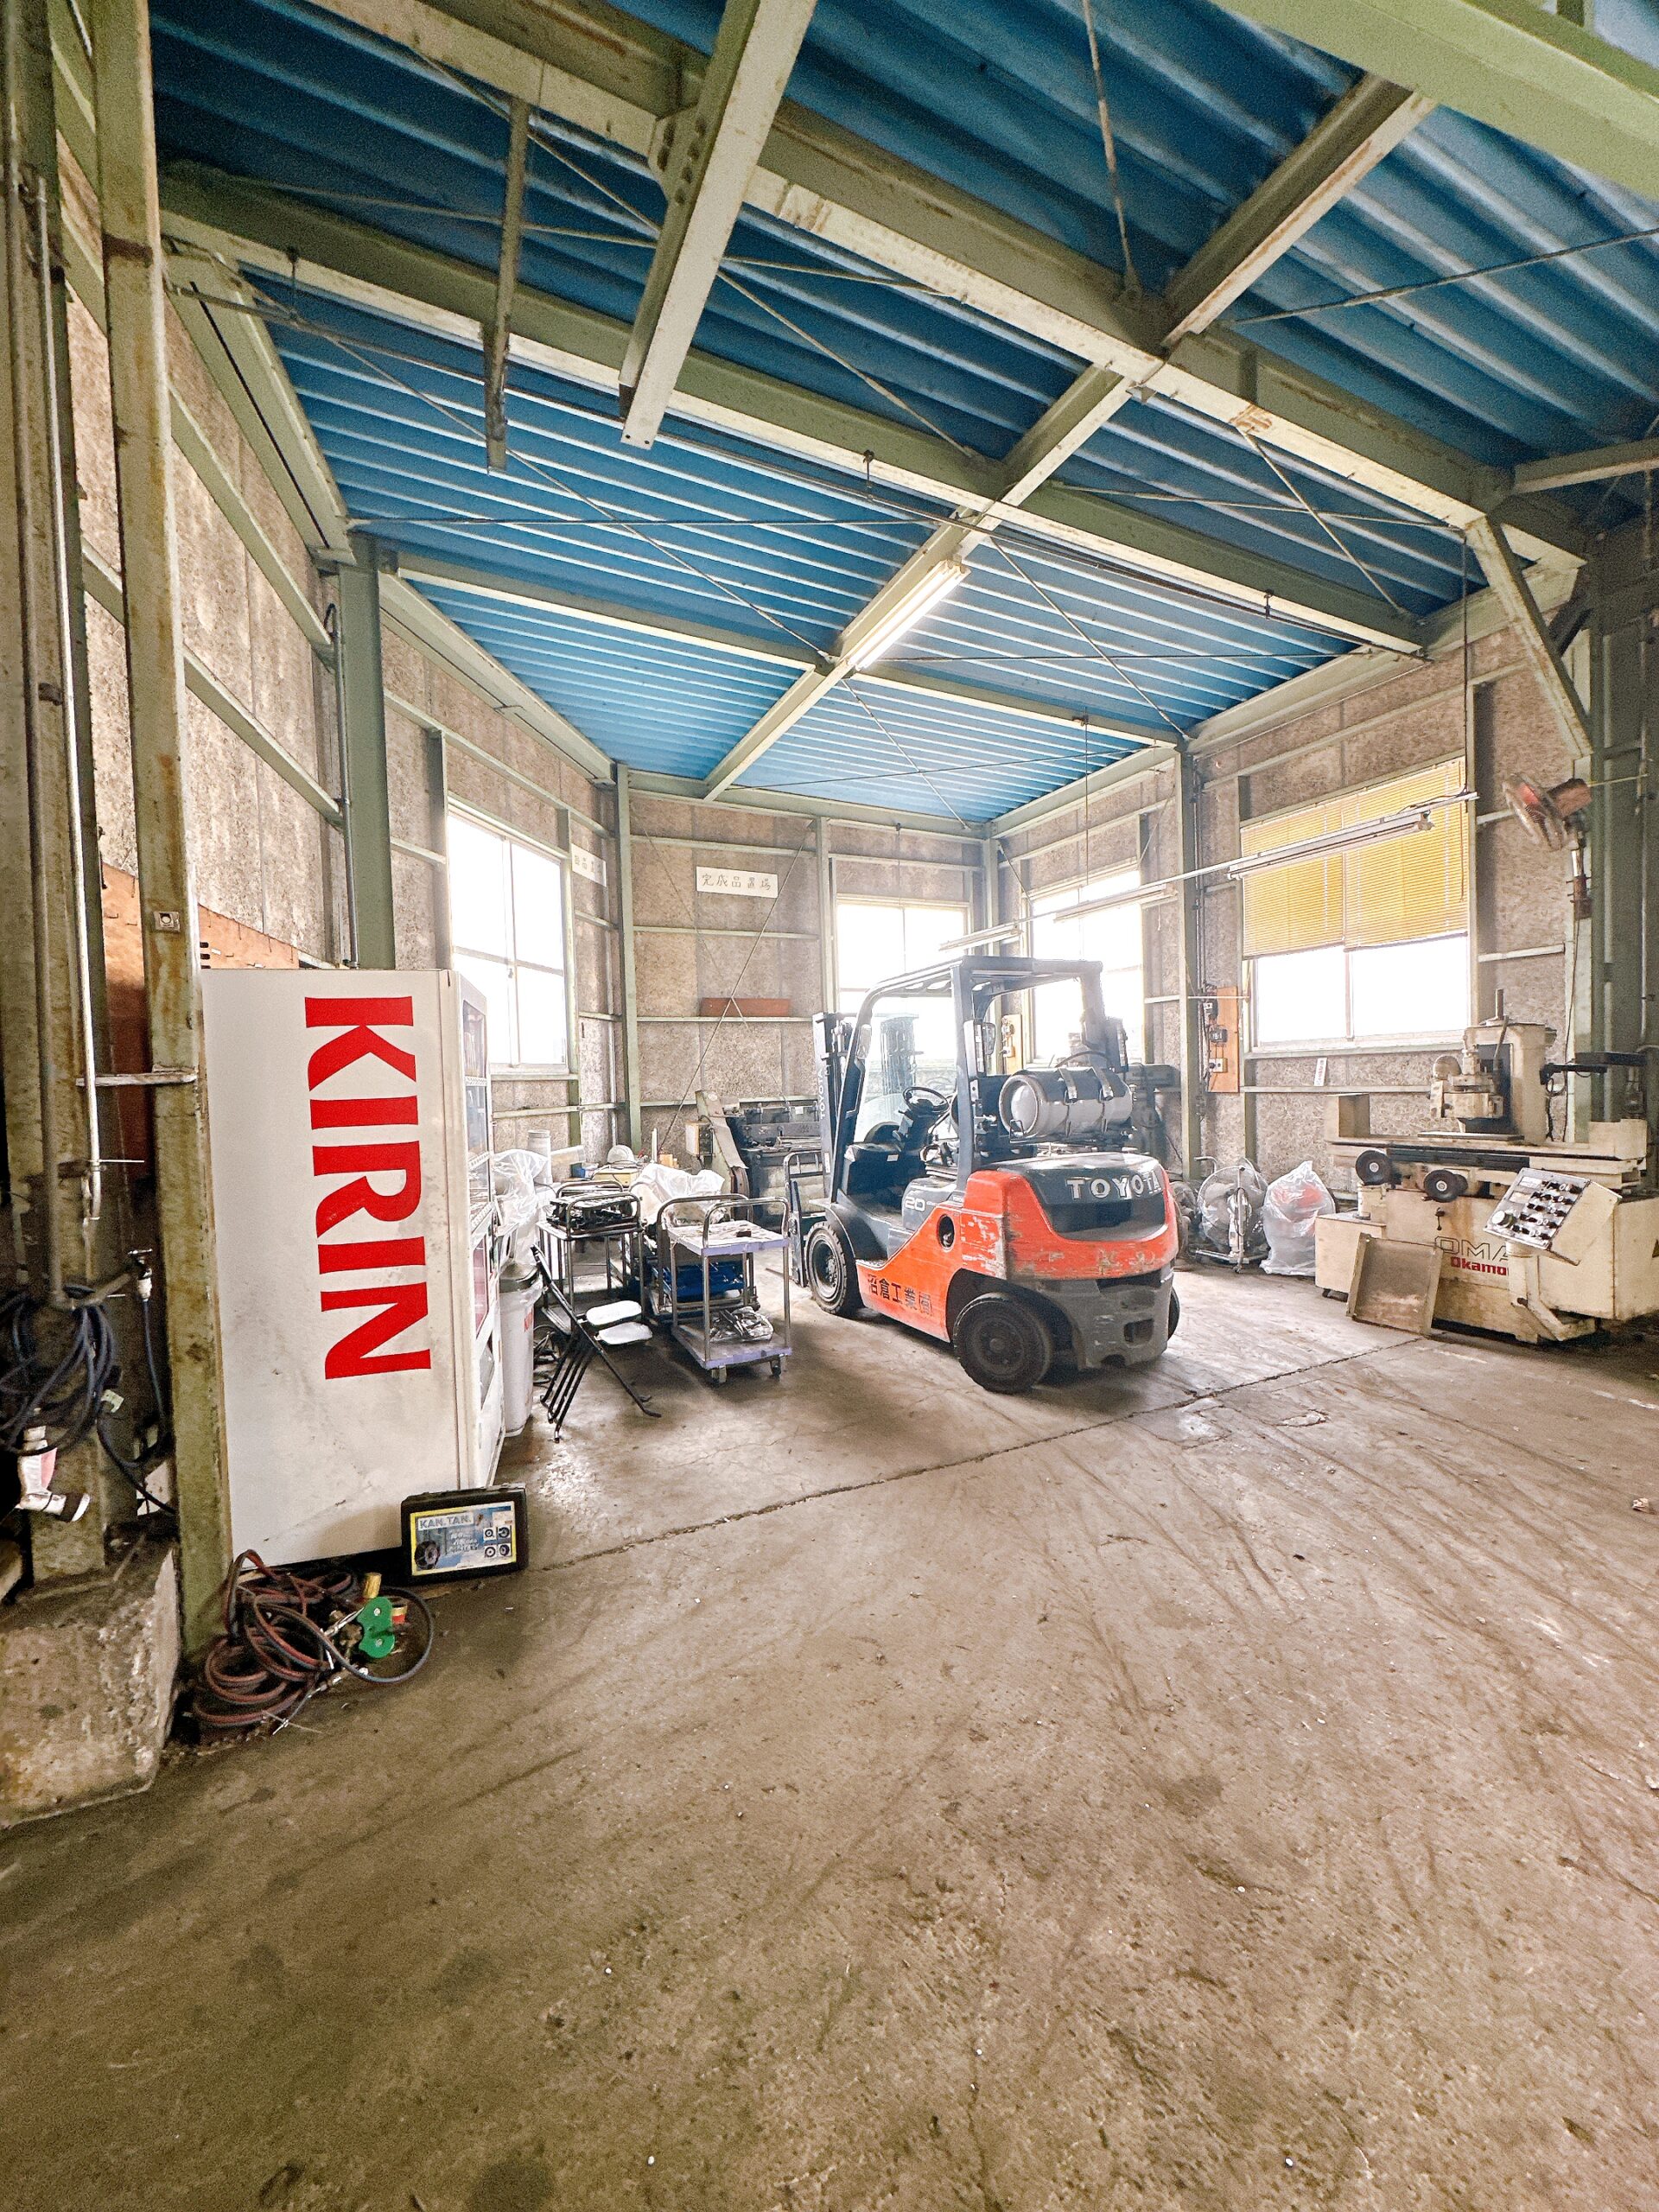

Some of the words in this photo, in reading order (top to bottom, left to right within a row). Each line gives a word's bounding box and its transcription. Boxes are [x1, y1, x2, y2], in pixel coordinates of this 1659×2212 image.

[817, 1070, 826, 1120] TOYOTA
[304, 995, 432, 1380] KIRIN
[1065, 1170, 1162, 1200] TOYOTA
[904, 1195, 925, 1212] 20
[1450, 1256, 1510, 1276] Okamo
